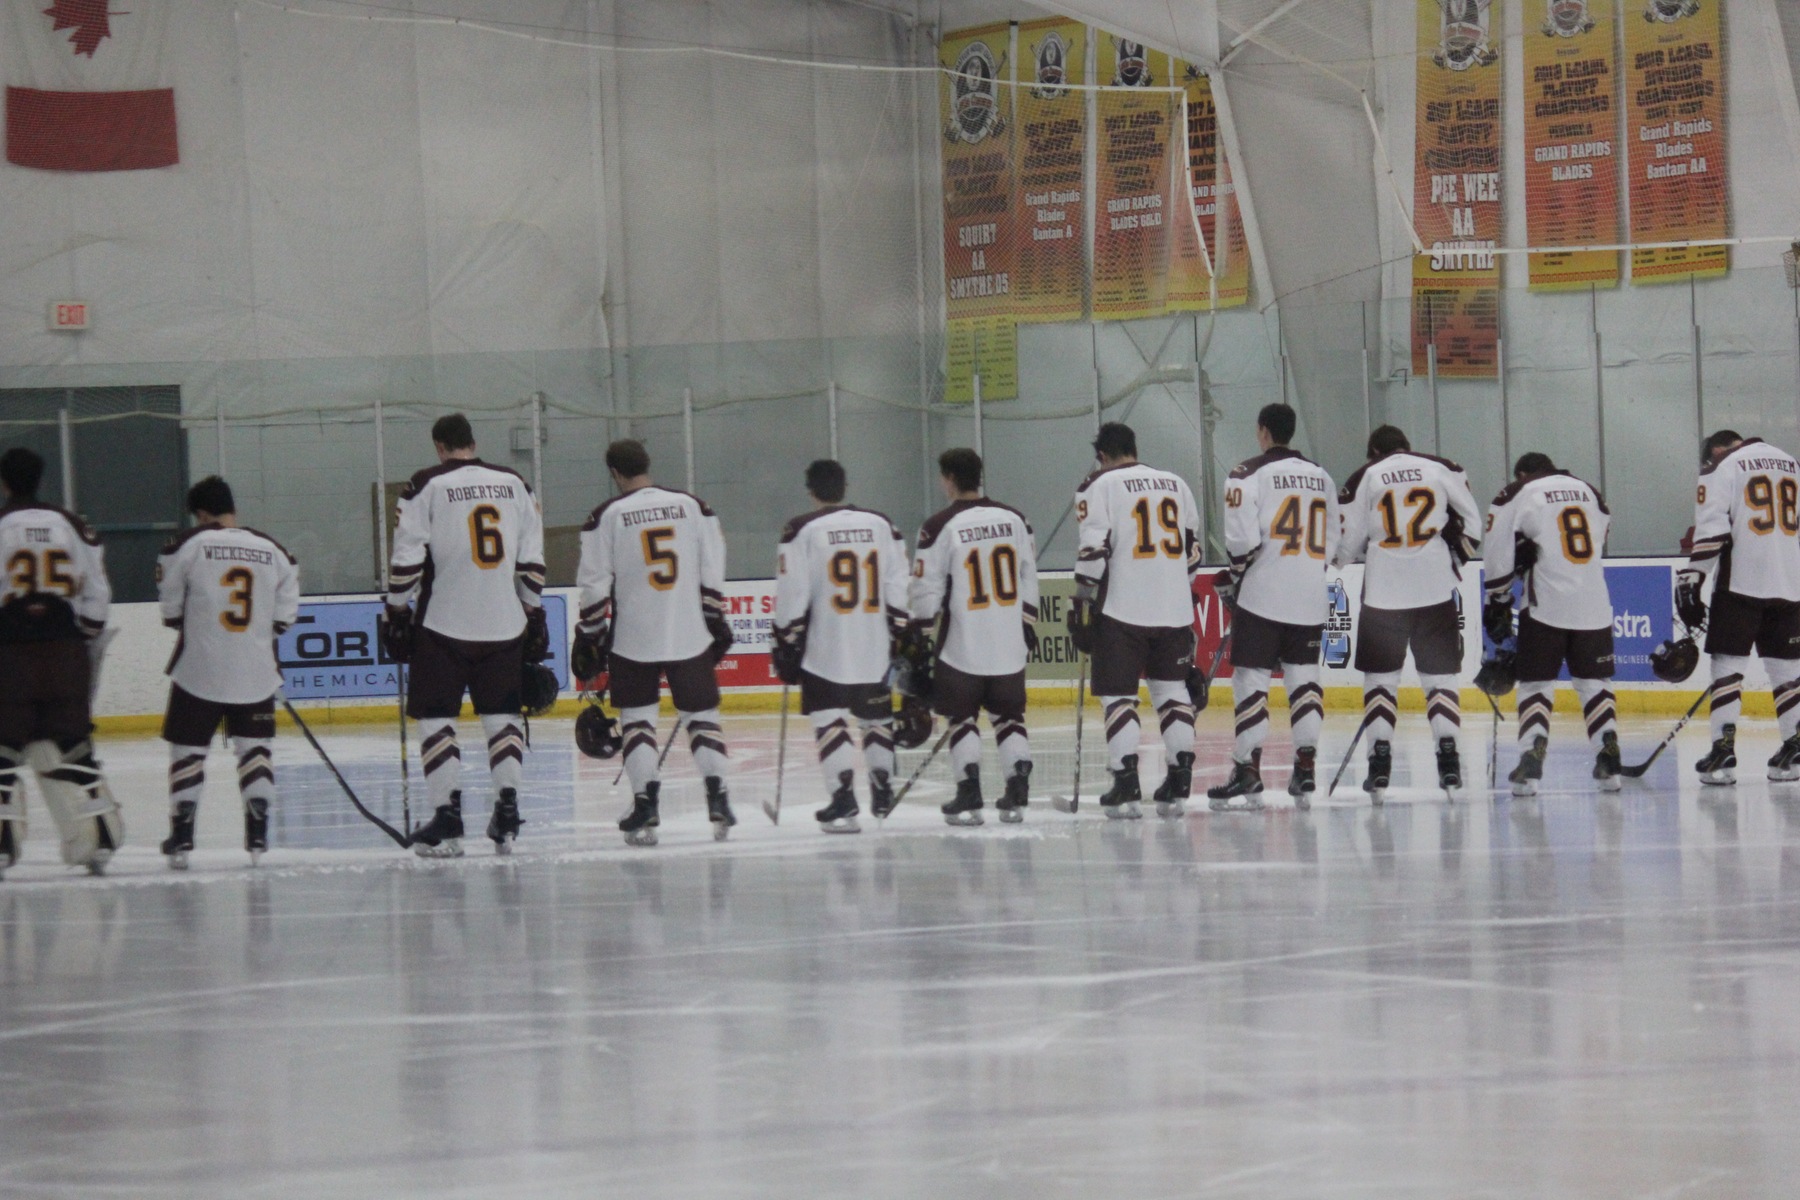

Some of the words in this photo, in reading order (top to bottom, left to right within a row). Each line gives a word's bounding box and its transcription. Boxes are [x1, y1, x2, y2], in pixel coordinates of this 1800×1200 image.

[1640, 123, 1669, 140] Grand
[1673, 117, 1713, 138] Rapids
[1535, 145, 1568, 162] GRAND
[1571, 141, 1611, 158] RAPIDS
[1655, 141, 1693, 158] Blades
[1552, 164, 1593, 180] BLADES
[1647, 163, 1687, 179] Bantam
[1690, 157, 1707, 173] AA
[1051, 189, 1081, 206] Rapids
[1431, 174, 1458, 203] PEE
[1462, 172, 1499, 202] WEE
[1107, 199, 1131, 213] GRAND
[1132, 195, 1162, 211] RAPIDS
[1037, 209, 1065, 222] Blades
[1111, 215, 1139, 230] BLADES
[1453, 208, 1474, 236] AA
[959, 223, 997, 247] SQUIRT
[1066, 225, 1073, 238] A
[972, 250, 986, 271] AA
[1737, 457, 1796, 474] VANOPHEM
[1123, 478, 1179, 493] VIRTANEN
[1381, 468, 1423, 485] OAKES
[446, 485, 515, 502] ROBERTSON
[1225, 487, 1242, 508] 40
[1544, 490, 1590, 504] MEDINA
[621, 504, 687, 527] HUIZENGA
[1743, 474, 1798, 537] 98
[1131, 496, 1184, 560] 19
[1269, 494, 1327, 560] 40
[1377, 487, 1438, 548] 12
[467, 503, 505, 570] 6
[827, 528, 874, 545] DEXTER
[958, 523, 1013, 543] ERDMANN
[1557, 505, 1595, 565] 8
[203, 545, 273, 565] WECKESSER
[640, 526, 678, 592] 5
[6, 549, 77, 602] 35
[826, 548, 880, 615] 91
[963, 544, 1018, 611] 10
[219, 566, 254, 633] 3
[1040, 595, 1062, 623] NE
[733, 619, 753, 630] FOR
[1611, 609, 1653, 638] stra
